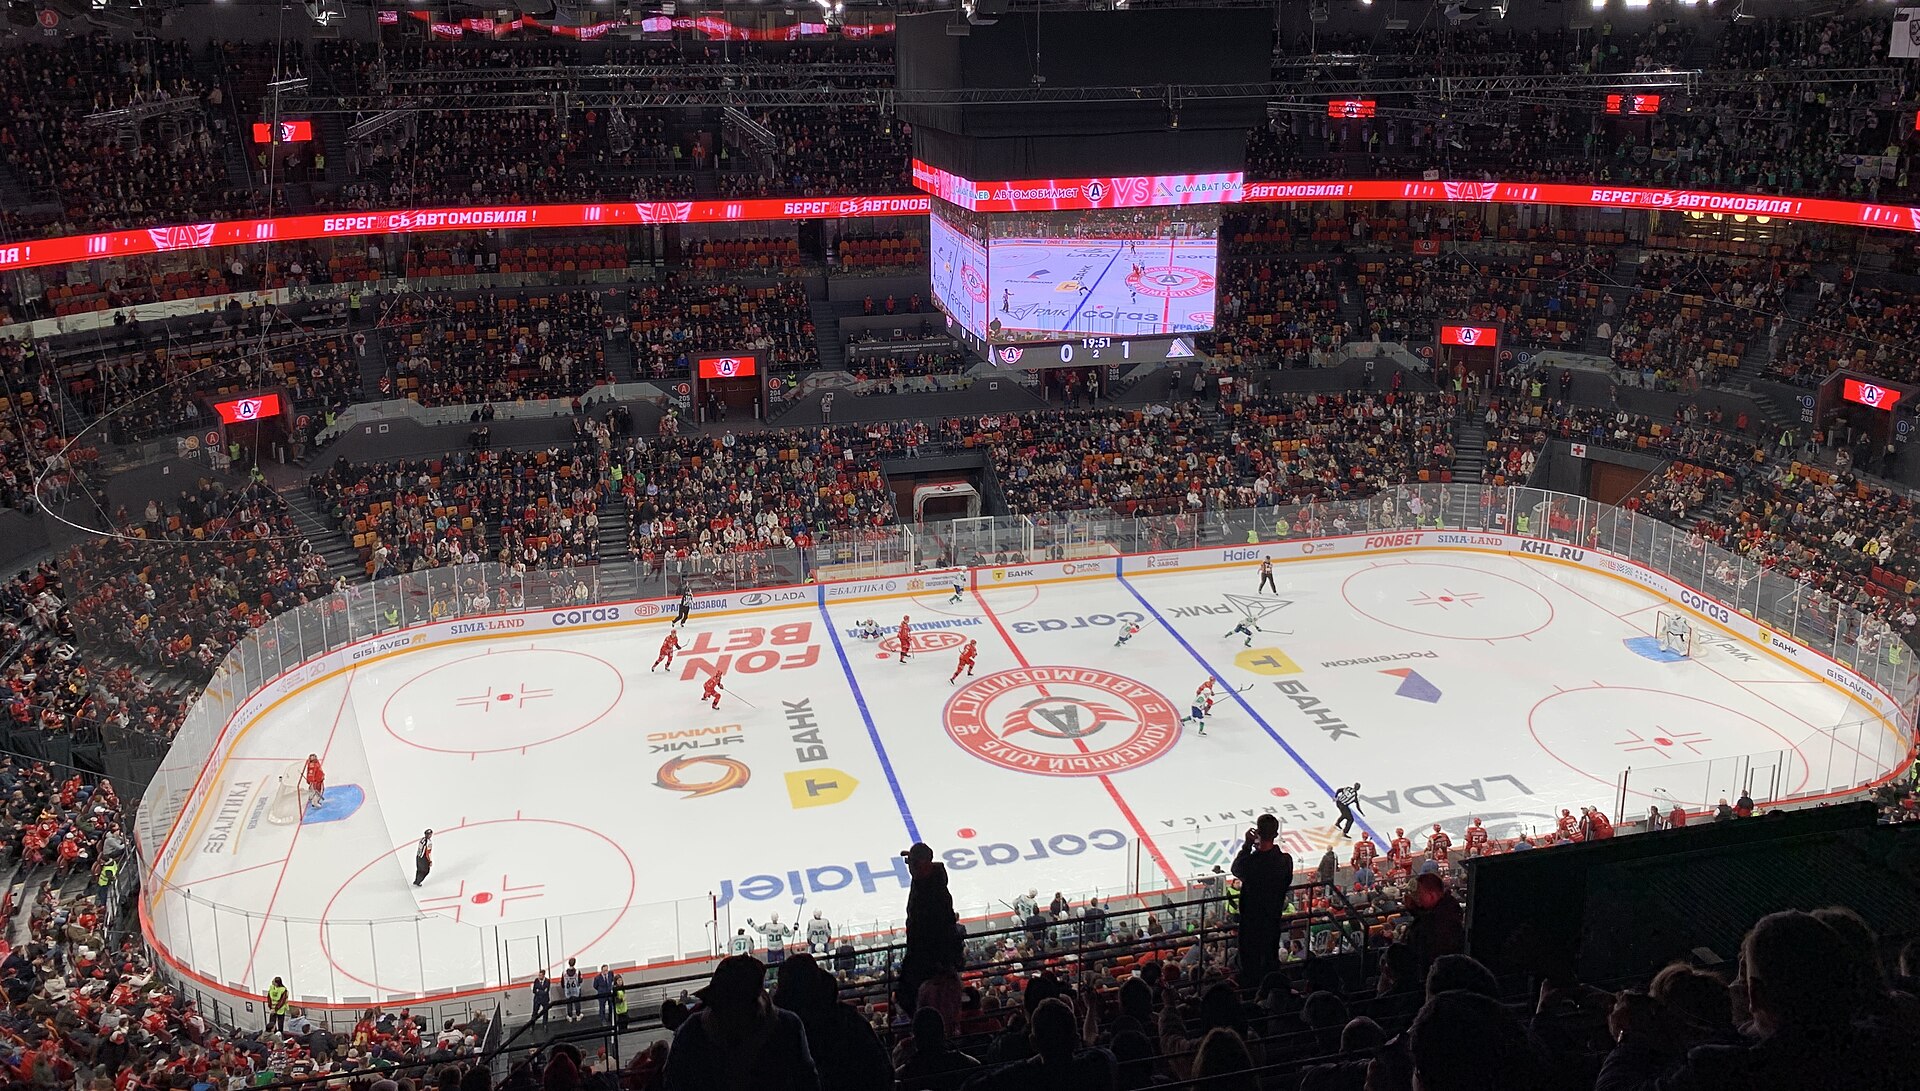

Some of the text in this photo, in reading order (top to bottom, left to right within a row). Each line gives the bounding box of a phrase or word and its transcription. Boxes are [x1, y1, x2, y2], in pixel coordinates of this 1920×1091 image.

[992, 187, 1078, 201] АВТОМОБИЛИСТ
[1111, 177, 1148, 204] VS
[1174, 182, 1220, 193] САЛАВАТ
[1250, 184, 1345, 198] АВТОМОБИЛЯ
[784, 198, 931, 215] БЕРЕГИСЬ АВТОМОБ
[1590, 189, 1672, 207] БЕРЕГИСЬ
[1677, 193, 1793, 214] АВТОМОБИЛЯ
[323, 214, 411, 232] БЕРЕГИСЬ
[415, 209, 528, 227] АВТОМОБИЛЯ
[1033, 308, 1070, 318] РМК
[1082, 306, 1158, 322] согаз
[1060, 344, 1073, 363] 0
[1082, 338, 1111, 350] 19:51
[1122, 341, 1129, 359] 1
[1092, 350, 1099, 358] 2
[1800, 415, 1813, 423] 203
[1801, 408, 1814, 416] 202
[1895, 434, 1907, 443] 202
[1364, 533, 1424, 549] FONBET
[1437, 534, 1503, 546] SIMA-LAND
[1223, 548, 1260, 562] Haier
[1520, 539, 1585, 562] KHL.RU
[1007, 569, 1034, 578] БАНК
[774, 591, 806, 602] LADA
[837, 583, 884, 595] БАЛТИКА
[552, 606, 620, 626] согаз
[1167, 602, 1234, 619] РМК
[1680, 589, 1729, 624] согаз
[450, 618, 525, 635] SIMA-LAND
[1011, 611, 1145, 634] согаз
[352, 637, 410, 660] GISLAVED
[676, 621, 813, 657] BET
[1771, 637, 1798, 657] БАНК
[679, 644, 821, 681] FON
[1321, 650, 1440, 669] Ростелеком
[1719, 643, 1759, 663] РМК
[309, 661, 326, 677] 20
[951, 668, 1145, 717] АВТОМОБИЛИСТ
[1826, 668, 1873, 701] GISLAVED
[1272, 679, 1361, 742] БАНК
[647, 723, 743, 742] UMMC
[781, 697, 829, 763] БАНК
[649, 734, 745, 755] УГМК
[979, 723, 1168, 773] ХОККЕЙНЫЙ КЛУБ
[1358, 773, 1535, 815] LADA
[208, 781, 253, 842] БАЛТИКА
[1161, 800, 1317, 828] CERAMICA
[942, 828, 1127, 871] согаз
[716, 856, 912, 908] Haier
